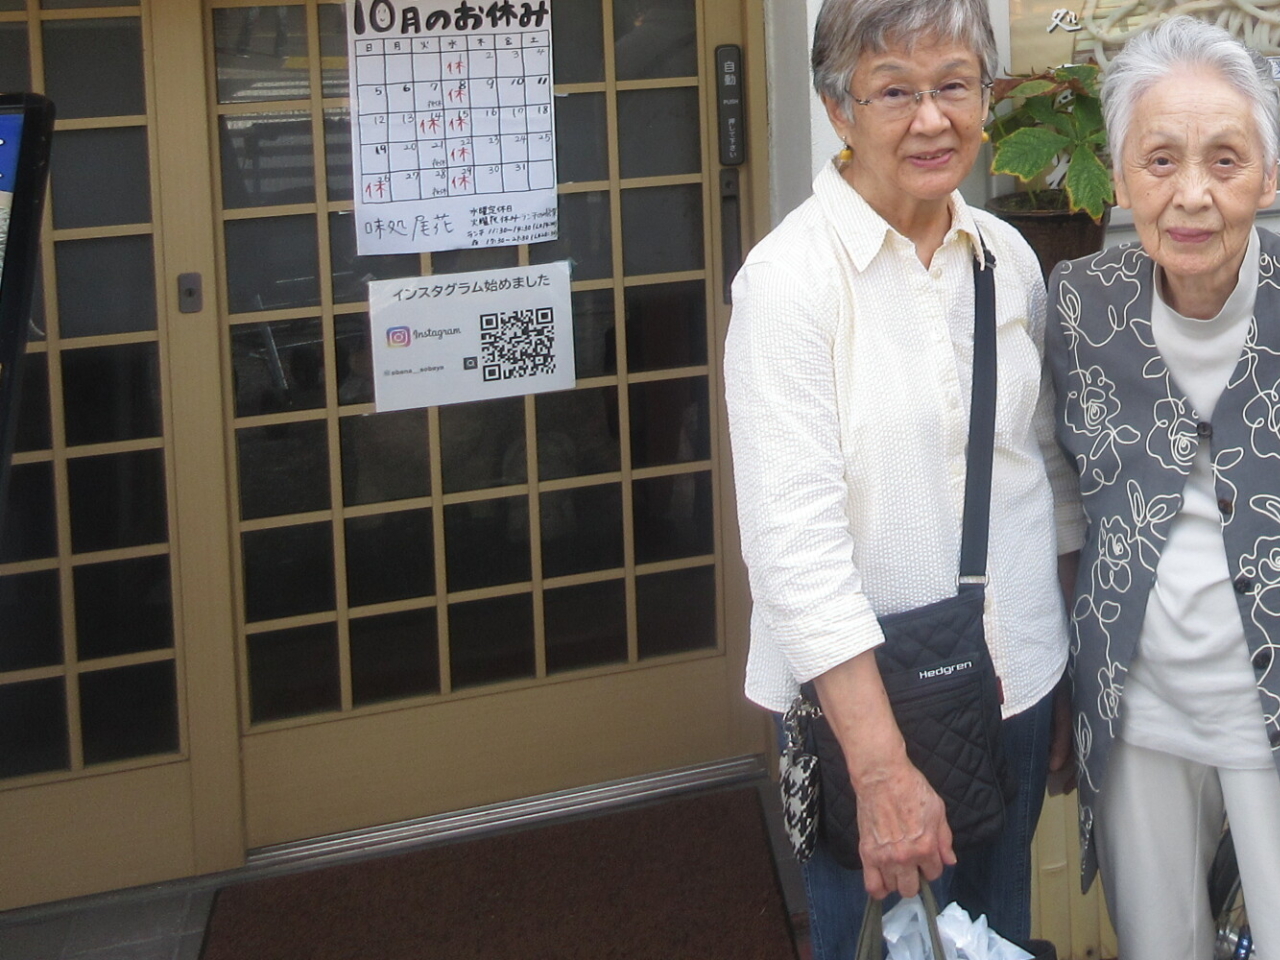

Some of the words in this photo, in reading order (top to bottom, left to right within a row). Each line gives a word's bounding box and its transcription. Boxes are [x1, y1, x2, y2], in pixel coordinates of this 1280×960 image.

[366, 43, 373, 52] 日
[394, 41, 401, 51] 月
[420, 41, 429, 50] 火
[448, 40, 457, 49] 水
[477, 38, 485, 46] 木
[505, 37, 512, 45] 金
[447, 61, 466, 74] 休
[375, 87, 382, 95] 5
[430, 83, 438, 91] 7
[459, 80, 466, 89] 8
[487, 79, 494, 89] 9
[448, 88, 466, 103] 休
[374, 116, 385, 125] 12
[402, 114, 414, 124] 13
[486, 108, 497, 116] 16
[537, 106, 548, 114] 18
[420, 118, 441, 134] 休
[449, 117, 468, 131] 休
[375, 145, 386, 154] 19
[431, 141, 443, 149] 21
[461, 138, 472, 146] 22
[488, 135, 500, 145] 23
[515, 135, 526, 144] 24
[538, 134, 550, 142] 25
[451, 147, 471, 162] 休
[378, 174, 390, 182] 26
[406, 172, 419, 180] 27
[435, 170, 446, 179] 28
[461, 167, 472, 176] 29
[489, 166, 499, 174] 30
[366, 180, 387, 198] 休
[452, 174, 471, 190] 休
[392, 274, 551, 301] インスタグラム始めました
[413, 326, 461, 340] Instagram
[919, 660, 972, 679] Hedgren
